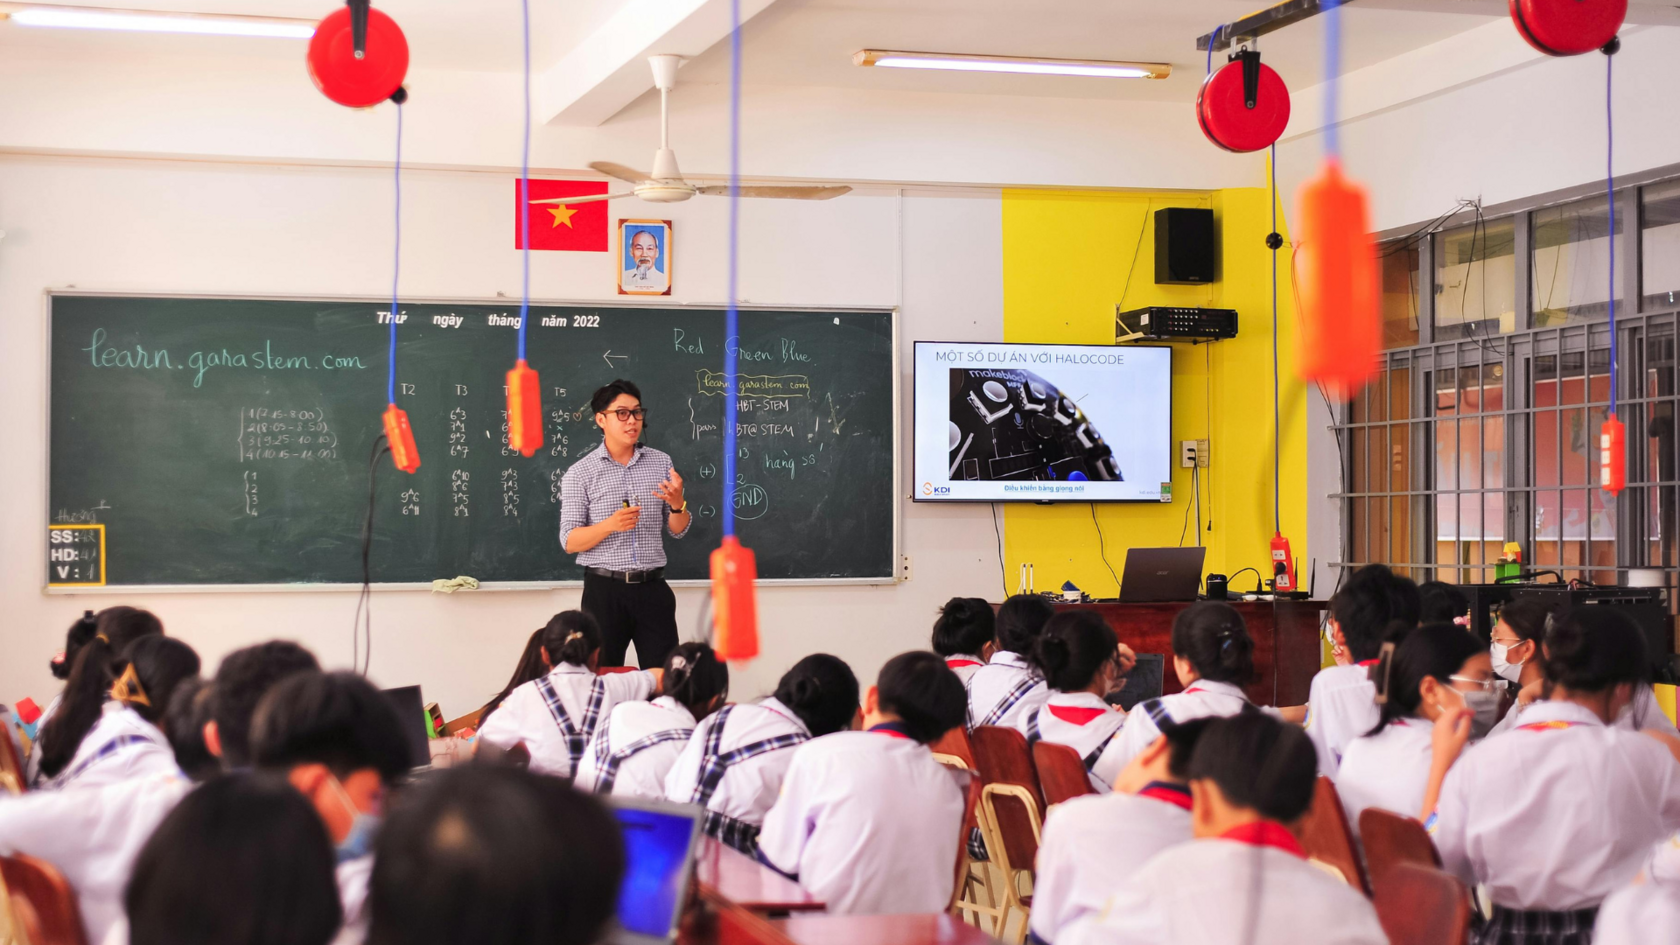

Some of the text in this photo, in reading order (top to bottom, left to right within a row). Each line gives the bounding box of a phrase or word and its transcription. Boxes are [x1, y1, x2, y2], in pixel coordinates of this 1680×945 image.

[377, 311, 600, 329] Thứ ngày tháng năm 2022
[673, 328, 704, 354] Red
[725, 335, 773, 361] Green
[82, 328, 367, 388] learn.garastem.com
[936, 351, 964, 363] MỘT
[967, 349, 984, 362] SỐ
[1009, 350, 1027, 363] ÁN
[1030, 351, 1052, 364] VỚI
[1055, 354, 1125, 365] HALOCODE
[401, 383, 416, 396] T2
[455, 384, 468, 396] T3
[554, 387, 567, 397] T5
[730, 487, 763, 509] GND
[933, 486, 951, 494] KDI
